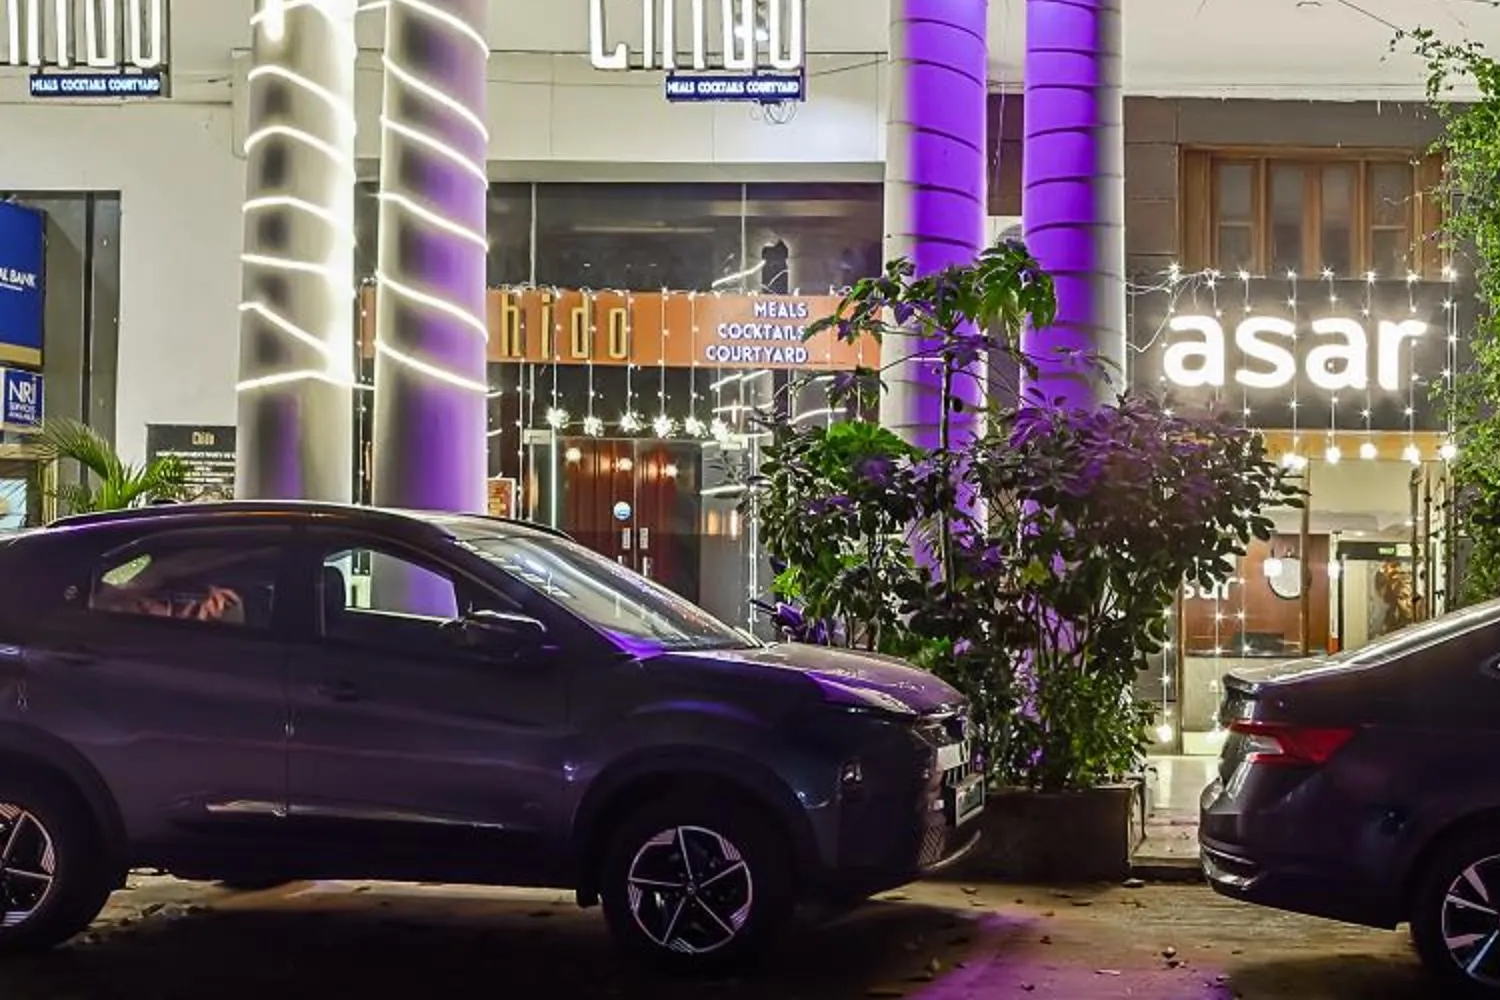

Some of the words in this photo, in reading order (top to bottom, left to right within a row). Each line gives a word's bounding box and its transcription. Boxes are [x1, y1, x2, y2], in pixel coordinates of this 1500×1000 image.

[10, 268, 37, 288] BANK
[755, 301, 807, 319] MEALS
[706, 345, 808, 364] COURTYARD
[1163, 314, 1428, 391] asar
